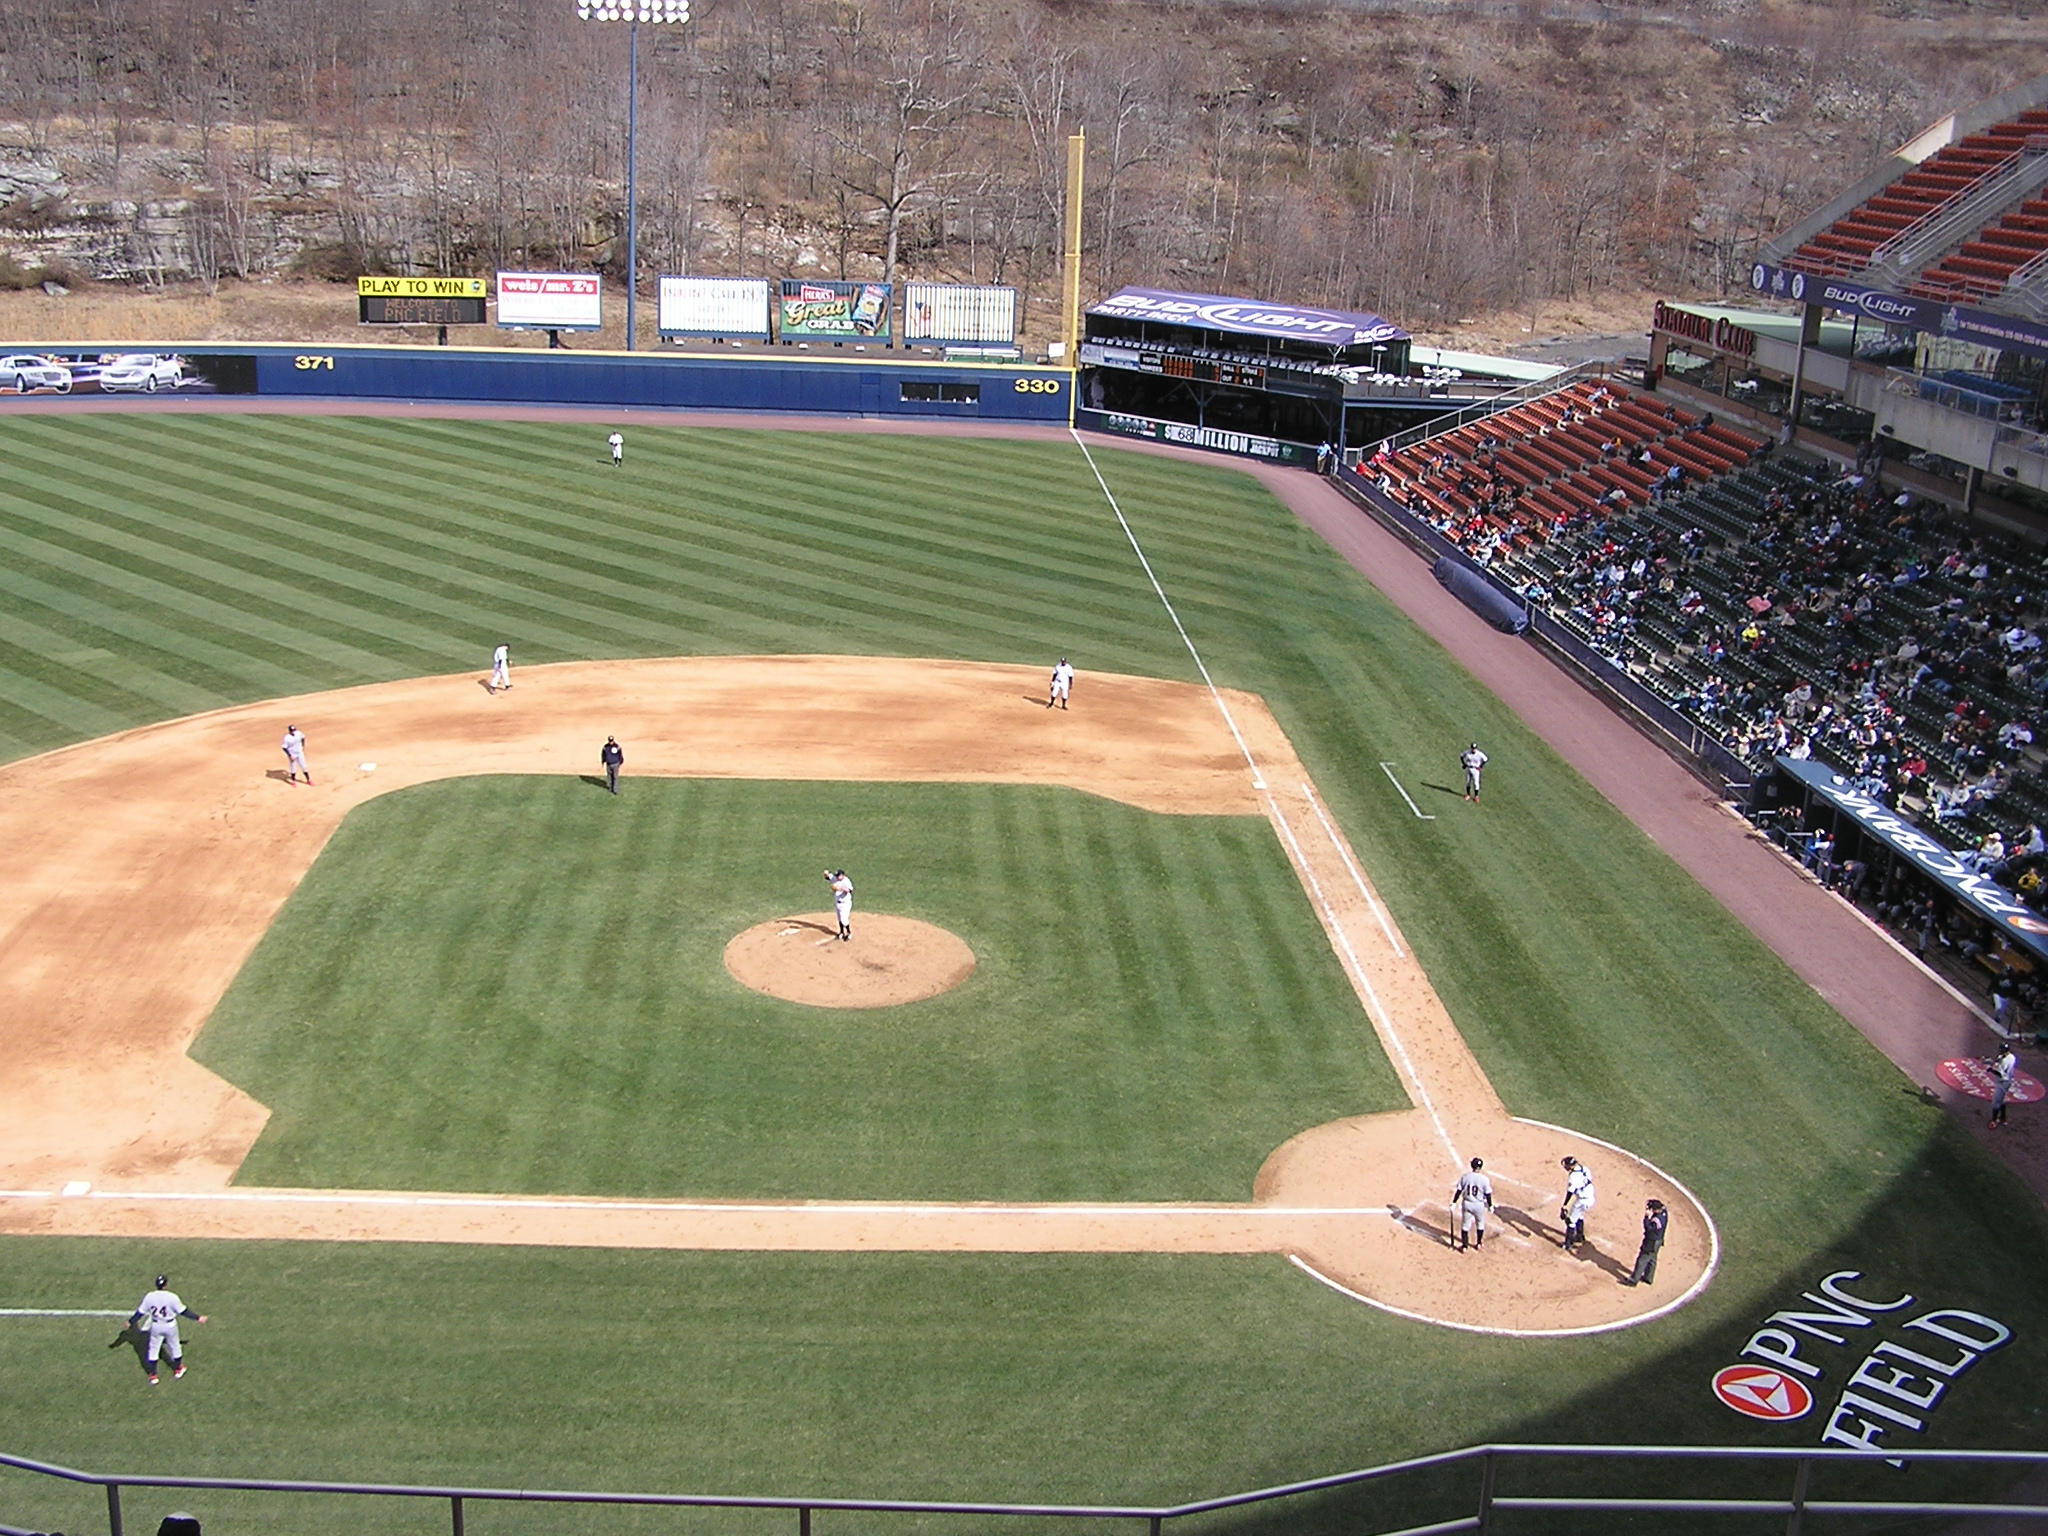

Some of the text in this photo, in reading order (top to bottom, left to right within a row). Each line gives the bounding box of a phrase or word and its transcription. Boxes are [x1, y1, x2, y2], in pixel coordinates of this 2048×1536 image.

[361, 279, 464, 294] PLAY TO WIN
[386, 298, 458, 309] WELCOME TO
[1823, 286, 1916, 318] BUD LIGHT
[384, 308, 462, 323] PNC FIELD
[784, 300, 846, 326] Great
[1092, 305, 1194, 323] PARTY DECK
[1104, 295, 1356, 332] BUD LIGHT
[807, 319, 856, 331] GRAB
[1653, 300, 1754, 357] STADIUM CLUB
[294, 355, 334, 370] 371
[1014, 378, 1060, 394] 330
[1193, 428, 1249, 453] MILLION
[1250, 443, 1280, 458] JACKPOT
[1820, 785, 2029, 914] PNC BANK
[150, 1305, 167, 1318] 24
[1740, 1270, 1915, 1378] PNC
[1821, 1309, 2013, 1468] FIELD
